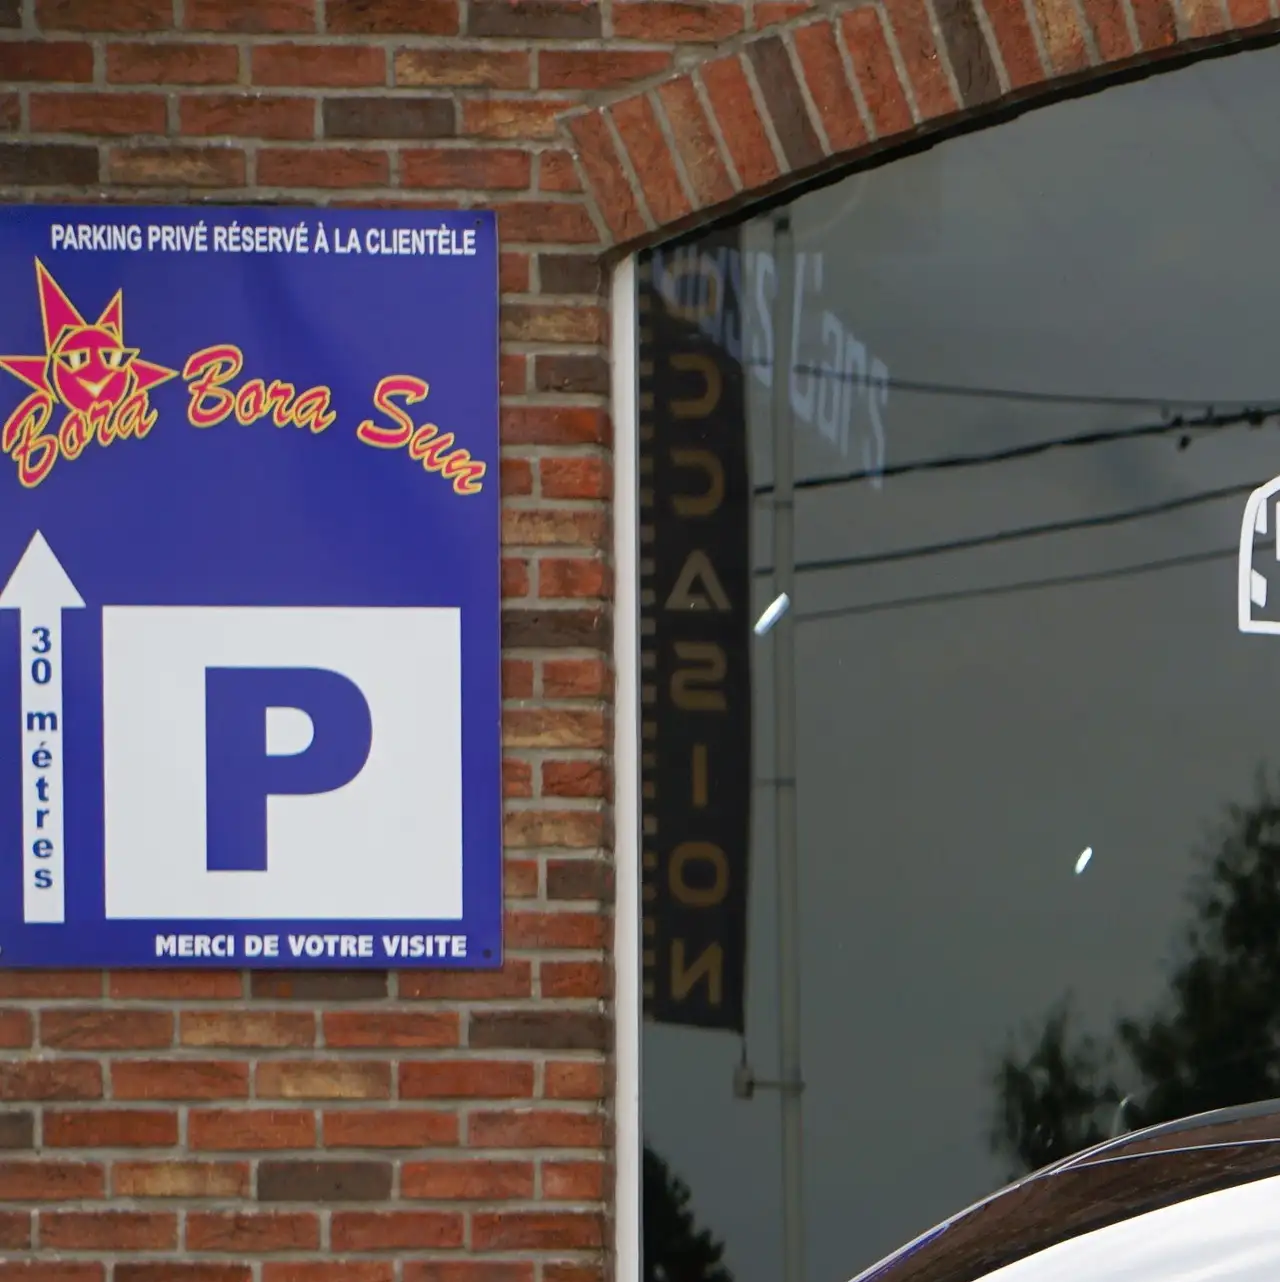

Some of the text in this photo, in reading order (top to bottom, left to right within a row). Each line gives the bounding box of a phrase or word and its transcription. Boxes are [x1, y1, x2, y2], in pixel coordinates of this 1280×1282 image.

[51, 221, 477, 255] PARKING PRIVÉ RÉSERVÉ À LA CLIENTÈLE
[2, 344, 487, 495] Bora Bora Sun
[26, 626, 58, 889] 30 métres
[205, 665, 373, 873] P
[155, 934, 467, 958] MERCI DE VOTRE VISITE
